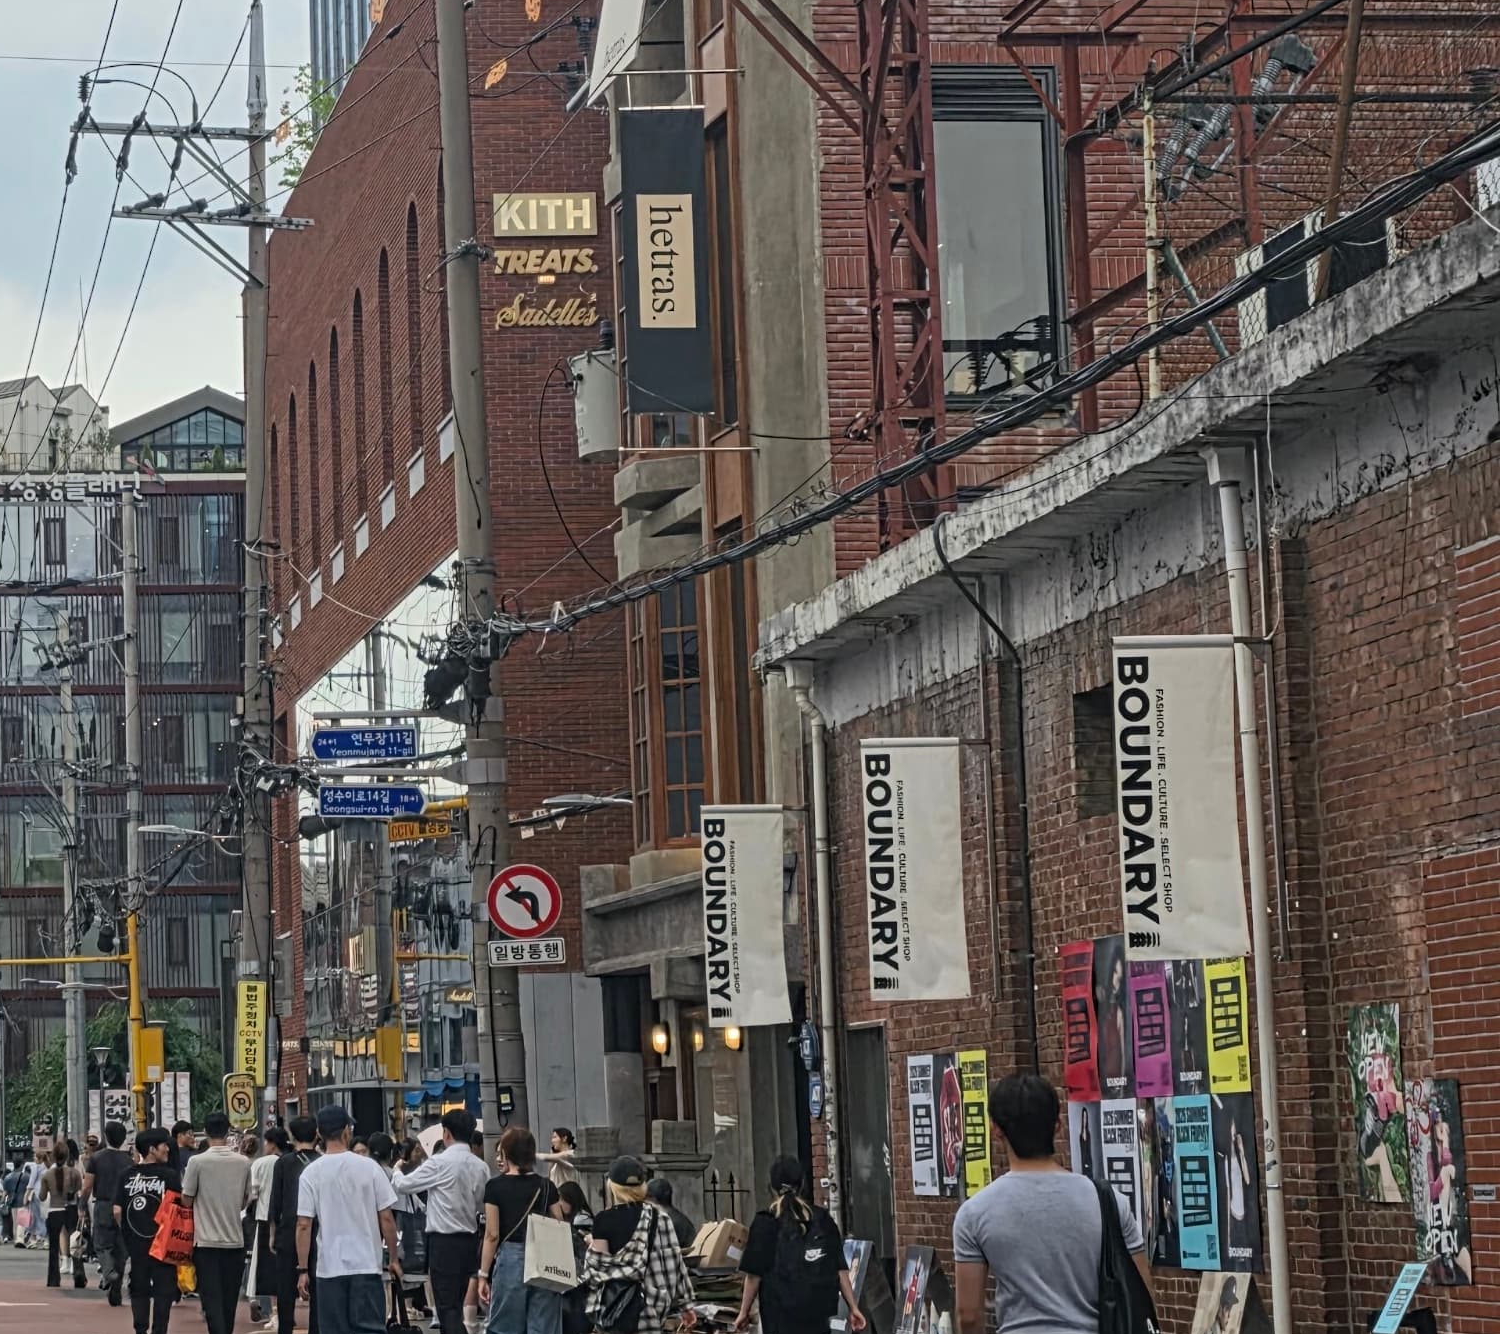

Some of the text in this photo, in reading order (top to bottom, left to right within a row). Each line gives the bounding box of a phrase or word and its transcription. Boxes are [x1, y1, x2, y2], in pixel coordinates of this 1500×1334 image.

[499, 198, 592, 231] KITH
[351, 731, 413, 746] 연무장11길
[330, 747, 413, 757] Yeonmujang 11-gil
[324, 790, 390, 803] 성수이로14길
[896, 780, 904, 820] FASHION
[1117, 656, 1160, 925] BOUNDARY
[1156, 688, 1173, 913] FASHION LIFE CULTURE SELECT SHOP
[323, 803, 378, 814] Seongsui-ro
[391, 823, 415, 838] CCTV
[865, 753, 899, 971] BOUNDARY
[898, 853, 907, 893] CULTURE
[703, 819, 731, 1002] BOUNDARY
[494, 942, 560, 960] 일방통행
[1361, 1029, 1386, 1055] NEW
[1358, 1056, 1390, 1082] OPEN
[1426, 1229, 1458, 1255] OPEN
